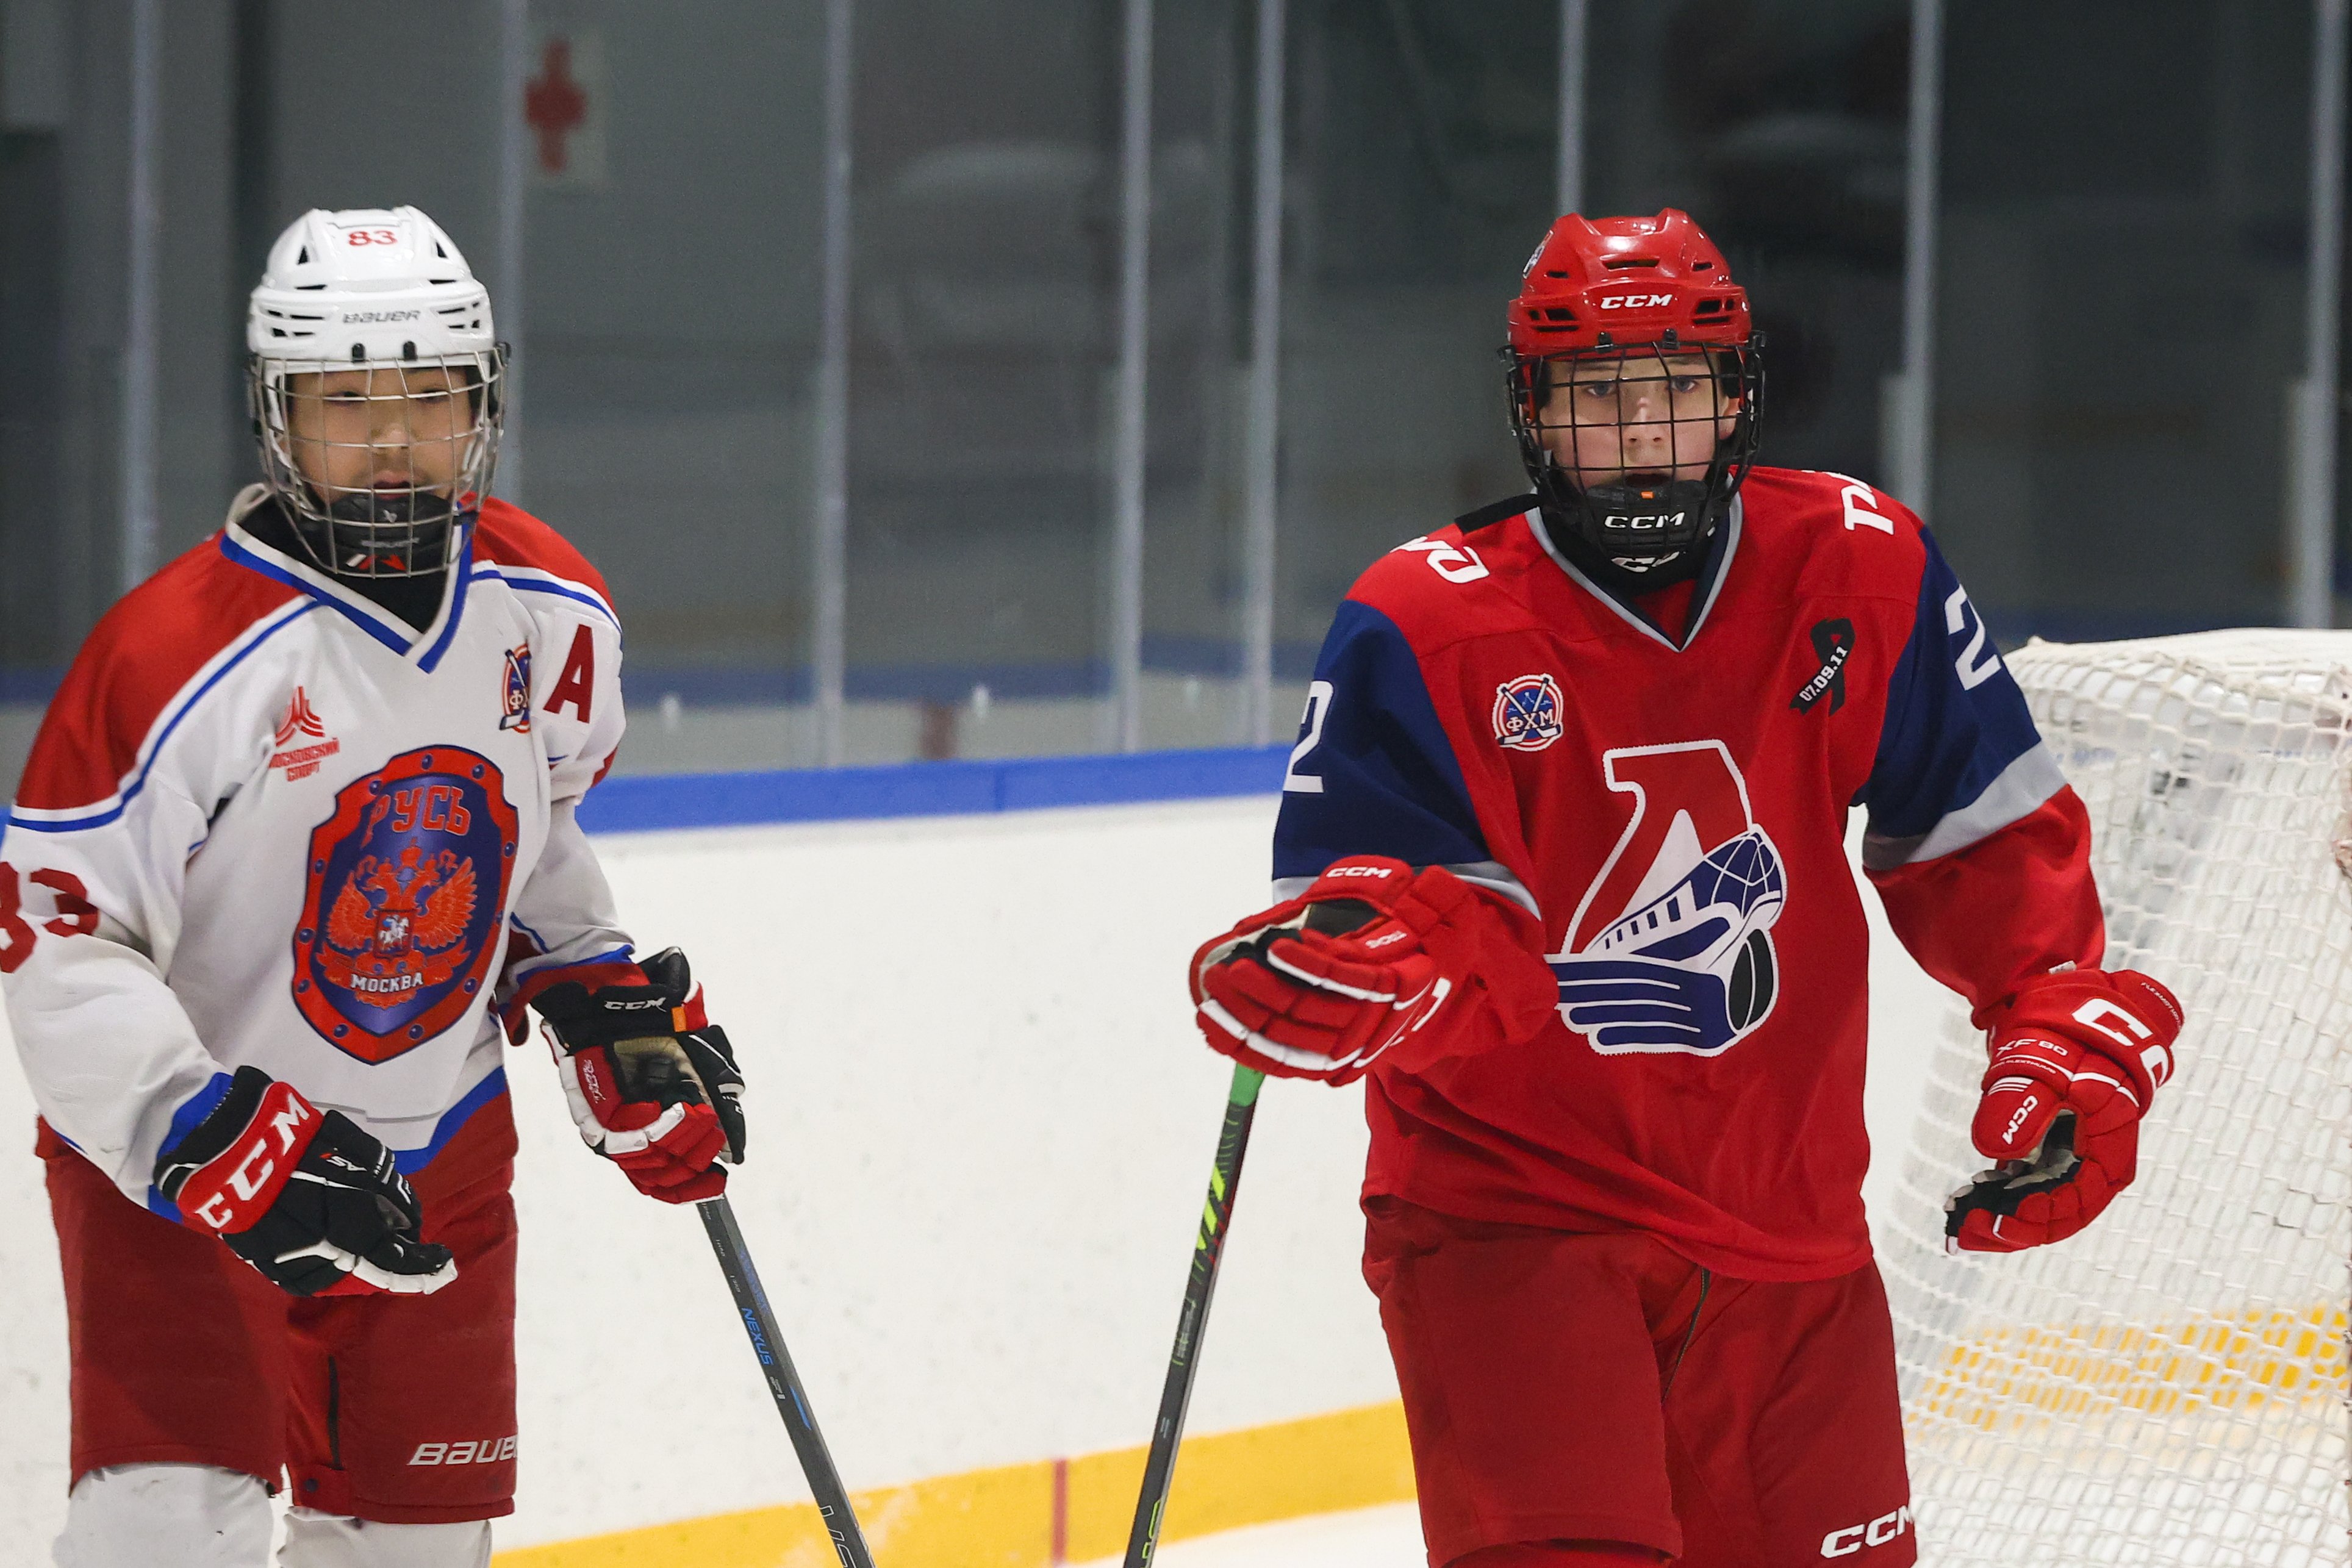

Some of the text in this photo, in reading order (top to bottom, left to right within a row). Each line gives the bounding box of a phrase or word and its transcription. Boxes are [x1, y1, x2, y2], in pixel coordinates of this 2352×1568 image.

[348, 230, 398, 246] 83
[1601, 294, 1673, 310] CCM
[1604, 511, 1685, 530] CCM
[543, 624, 595, 724] A
[1799, 646, 1848, 703] 07.09.11
[1506, 709, 1554, 732] ФХМ
[360, 784, 471, 848] РУСЬ
[1326, 866, 1393, 879] CCM
[350, 972, 424, 993] МОСКВА
[604, 997, 667, 1012] CCM
[2002, 1095, 2038, 1145] CCM
[195, 1092, 310, 1229] CCM
[741, 1307, 773, 1366] NEXUS
